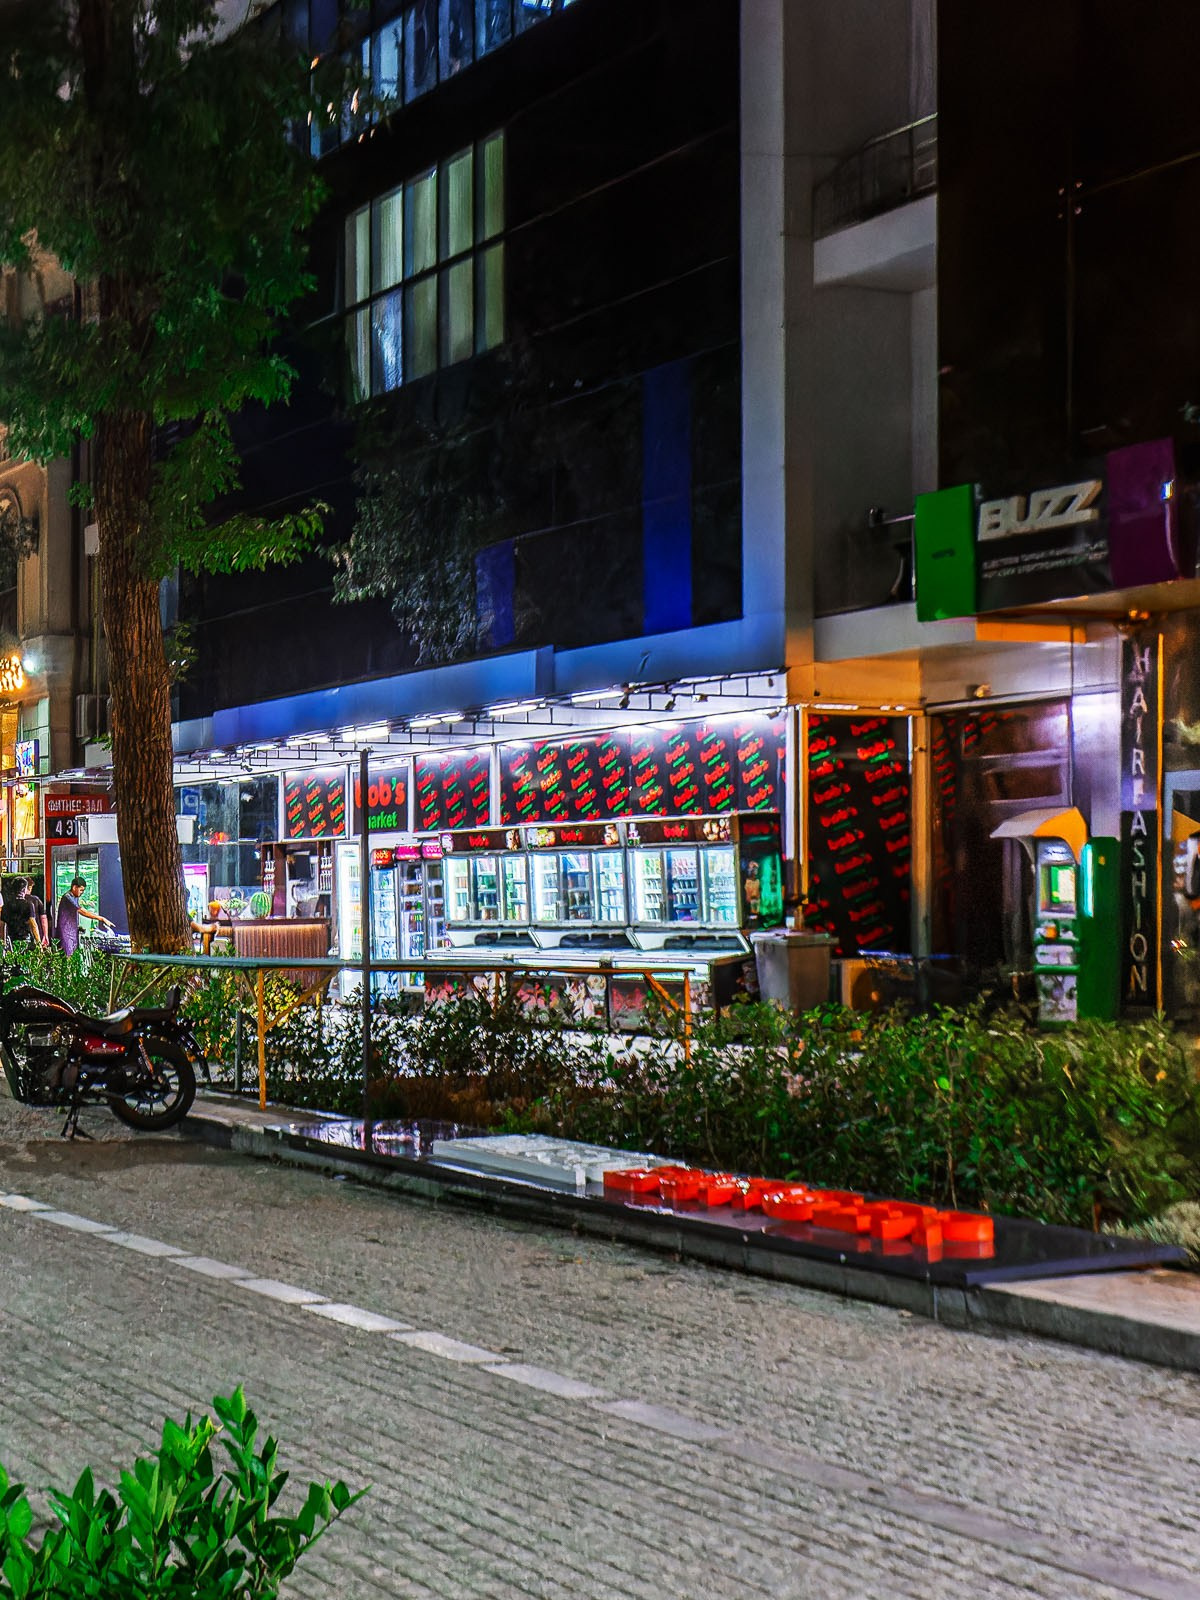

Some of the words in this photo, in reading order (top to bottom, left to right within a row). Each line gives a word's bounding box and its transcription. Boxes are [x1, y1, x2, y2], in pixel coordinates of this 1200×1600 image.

[978, 479, 1102, 542] BUZZ
[1131, 645, 1150, 776] HAIR
[48, 799, 103, 812] ФИТНЕС-ЗАЛ
[368, 811, 398, 829] arket
[56, 820, 63, 836] 4
[1131, 778, 1148, 992] FASHION
